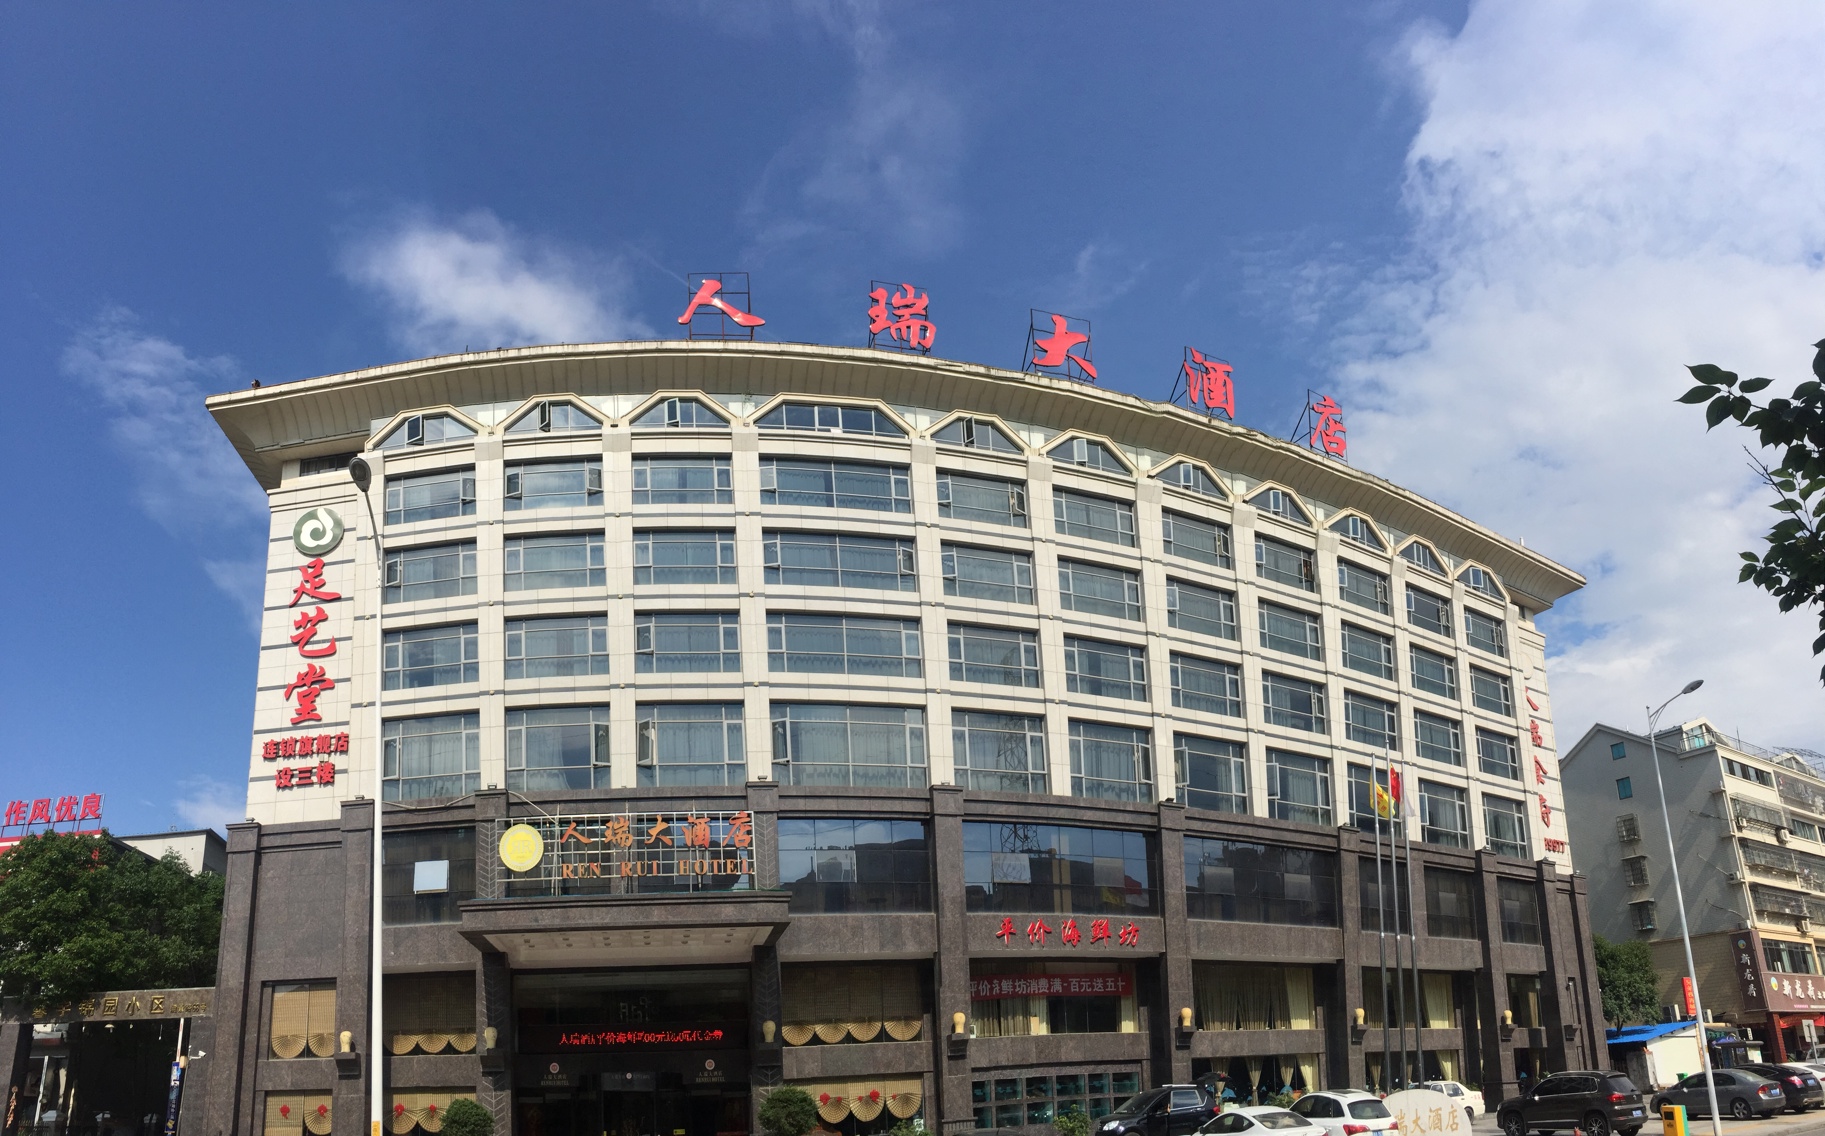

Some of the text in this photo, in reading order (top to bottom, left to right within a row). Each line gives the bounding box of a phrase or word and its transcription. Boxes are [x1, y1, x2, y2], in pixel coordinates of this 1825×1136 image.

[678, 279, 1347, 459] 人瑞大酒店
[284, 557, 342, 724] 足艺堂
[262, 732, 349, 760] 连锁旗舰店
[274, 763, 335, 788] 设三楼
[5, 793, 101, 826] 作风优良
[561, 811, 752, 849] 人瑞大酒店
[561, 859, 753, 879] REN RUI HOTEL
[996, 917, 1140, 947] 平价海鲜坊
